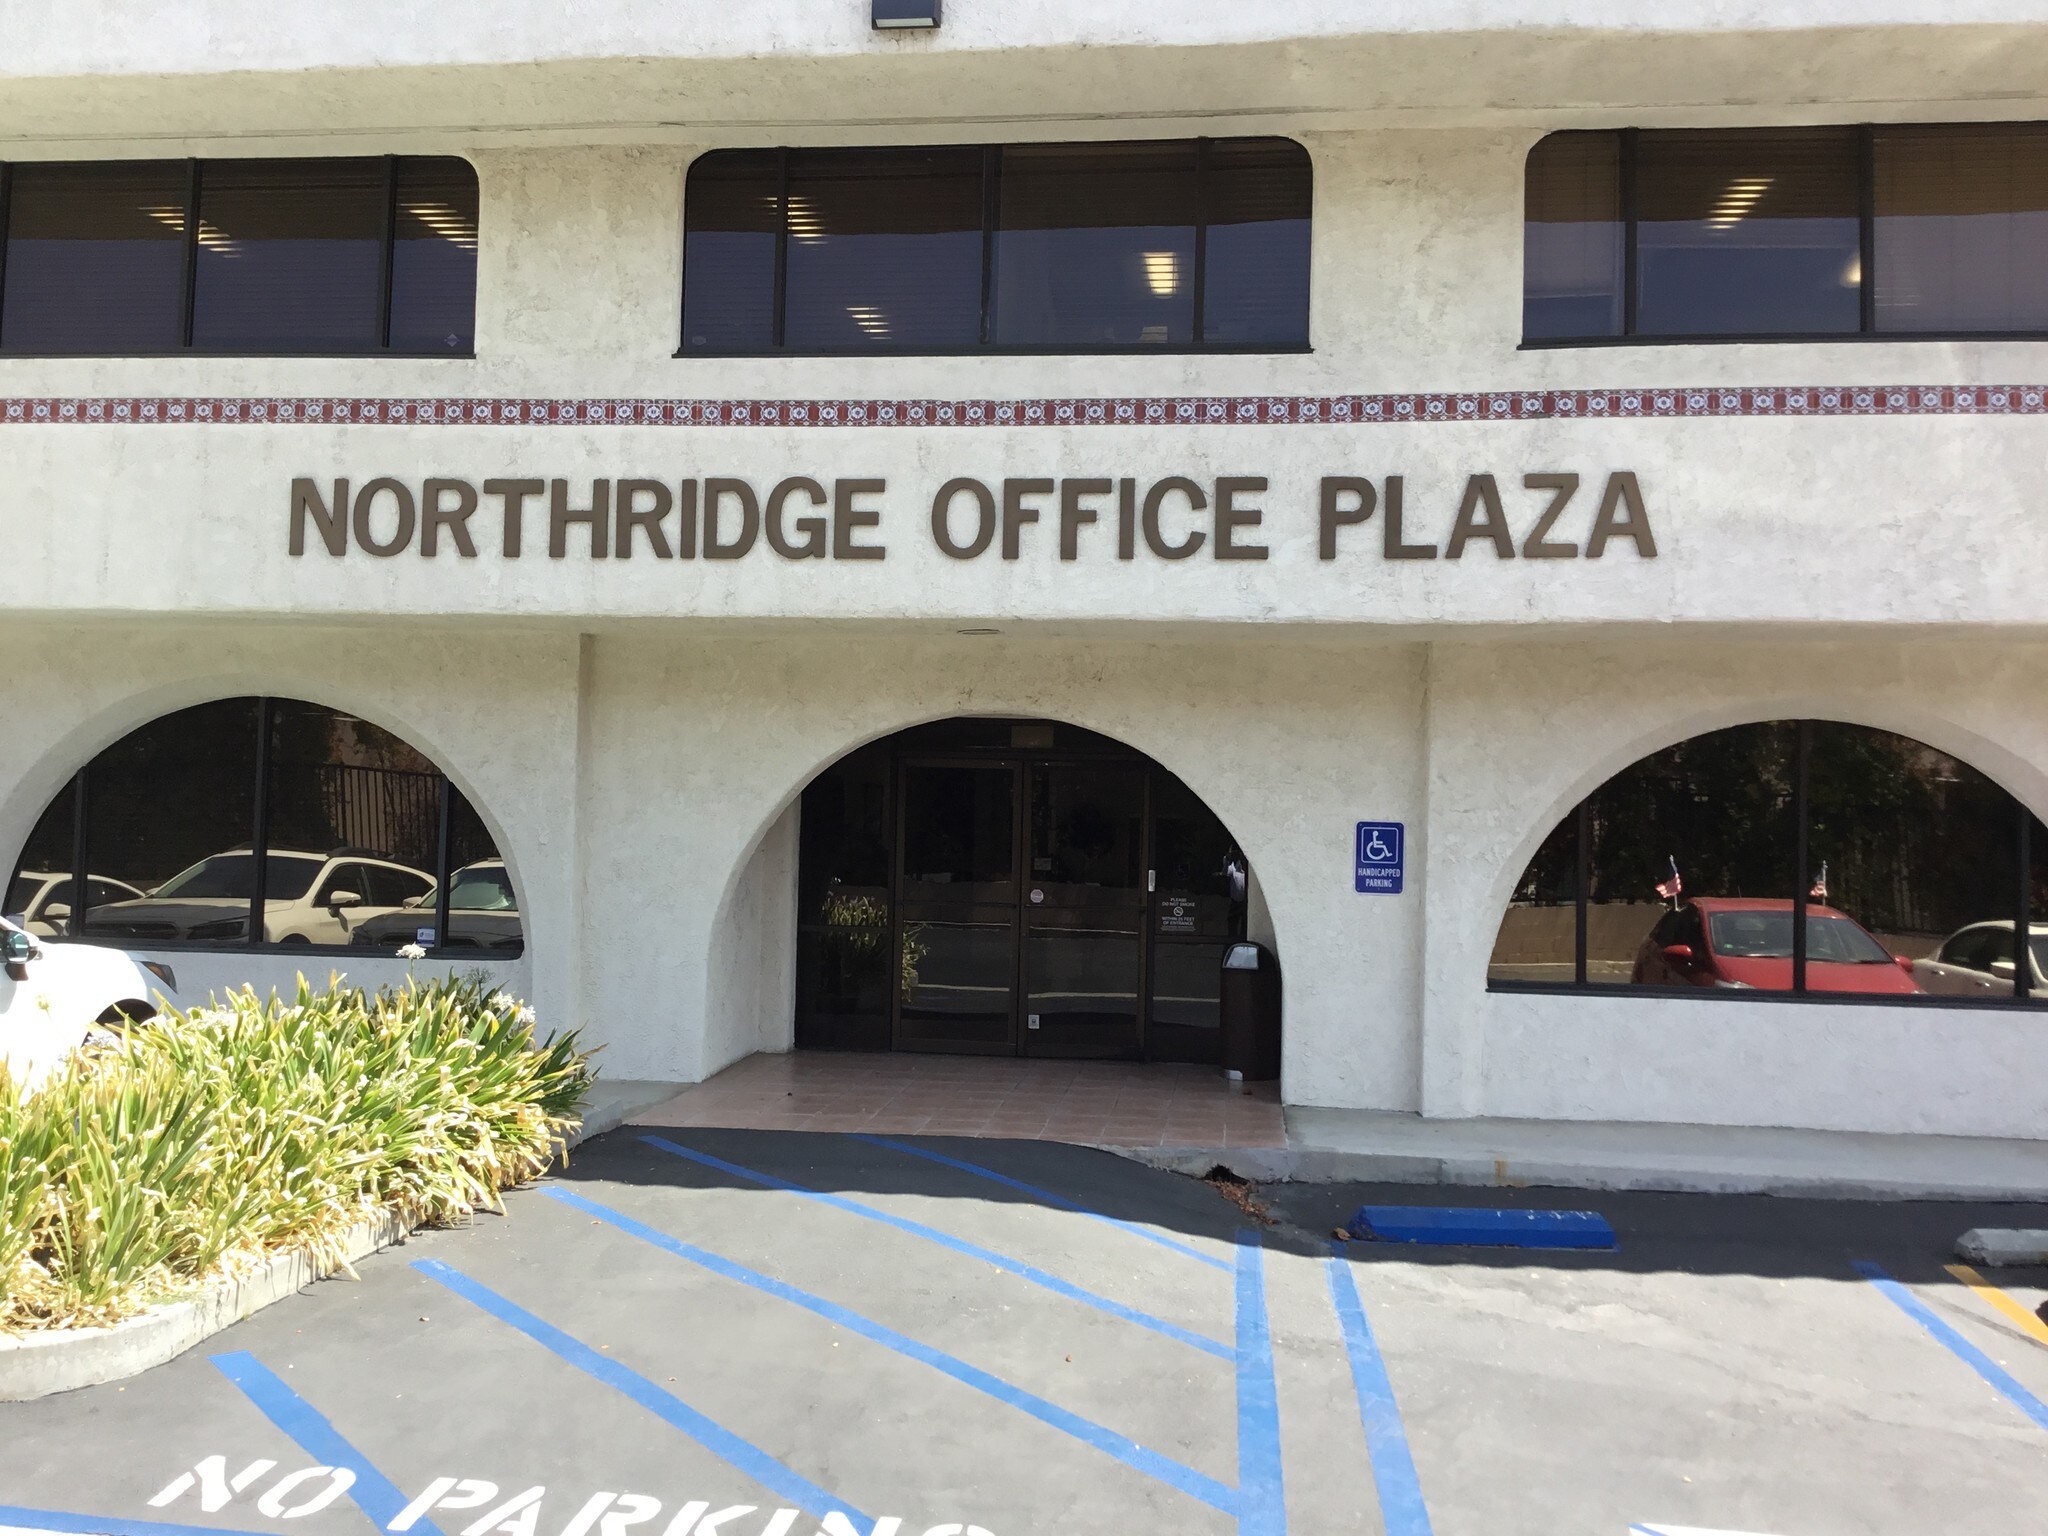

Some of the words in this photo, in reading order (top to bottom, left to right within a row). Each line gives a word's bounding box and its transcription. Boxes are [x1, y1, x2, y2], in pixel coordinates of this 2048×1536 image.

[288, 476, 886, 560] NORTHRIDGE
[931, 475, 1269, 561] OFFICE
[1318, 471, 1658, 560] PLAZA
[1357, 867, 1401, 878] HANDICAPPED
[1365, 878, 1393, 888] PARKING
[147, 1455, 357, 1519] NO
[386, 1476, 998, 1536] PARK
